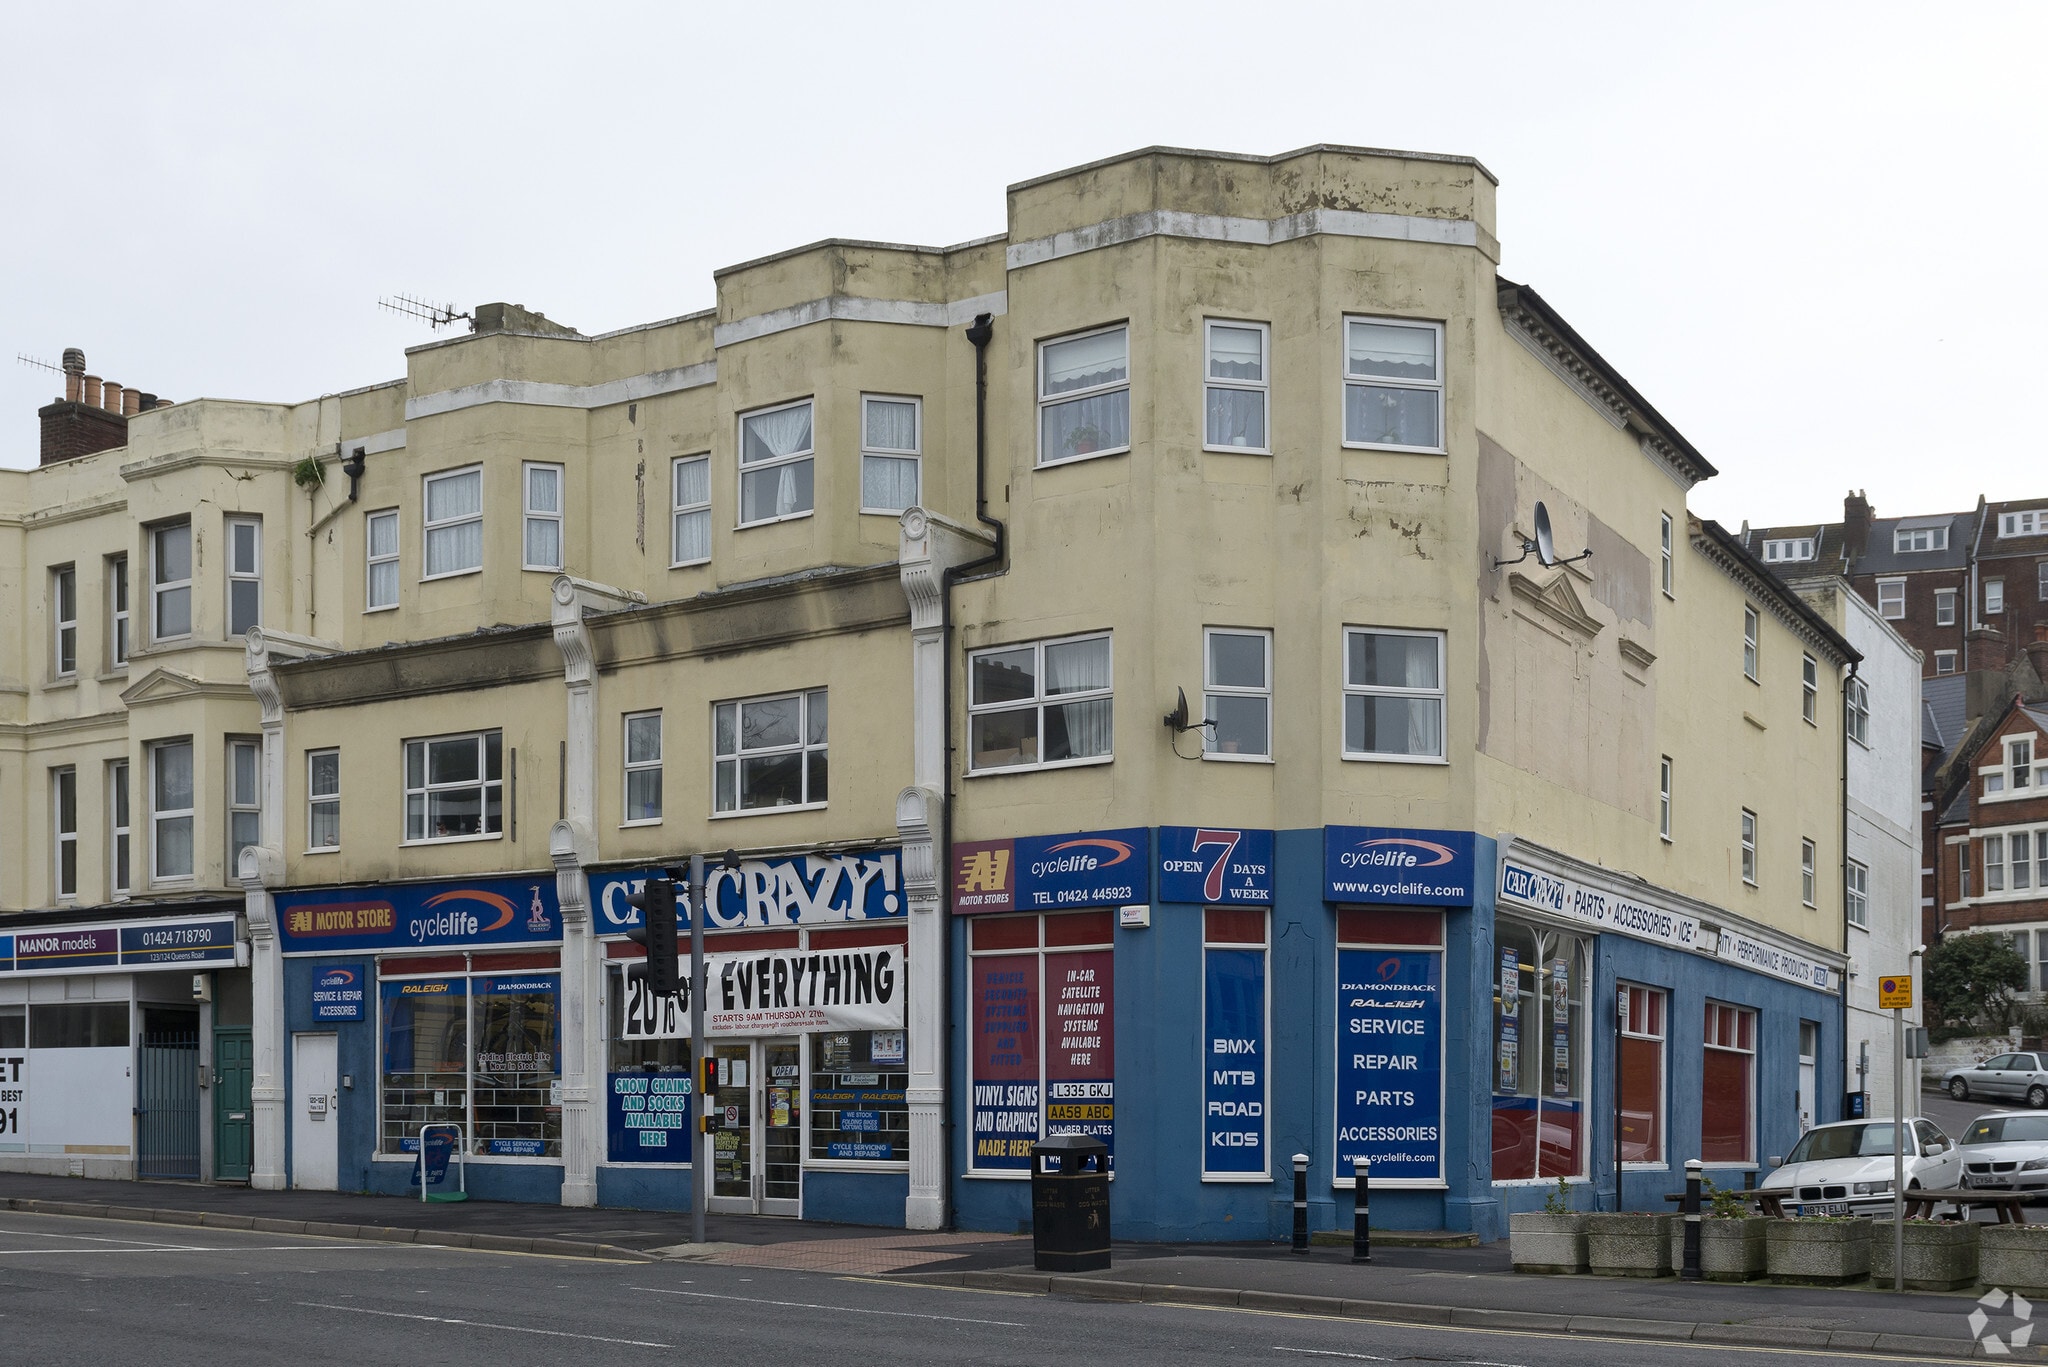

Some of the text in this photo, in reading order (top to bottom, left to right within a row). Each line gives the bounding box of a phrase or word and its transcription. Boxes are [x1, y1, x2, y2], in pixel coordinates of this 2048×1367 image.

[1192, 829, 1241, 901] 7
[1341, 850, 1417, 868] cyclelife
[1031, 855, 1098, 878] cyclelife
[1163, 860, 1203, 872] OPEN
[1233, 864, 1266, 874] DAYS
[1244, 877, 1254, 886] A
[705, 854, 899, 928] CRAZY!
[1033, 887, 1132, 904] TEL 01424 445923
[1229, 889, 1269, 899] WEEK
[1333, 882, 1464, 897] www.cyclelife.com
[1506, 870, 1564, 908] CAR CRAZY!
[959, 893, 1009, 906] MOTOR STORES
[316, 909, 391, 931] MOTOR STORE
[1573, 890, 1692, 943] PARTS ACCESSORIES ICE
[410, 912, 479, 943] cyclelife
[20, 934, 97, 953] MANOR models
[143, 928, 212, 946] 01424 718790
[150, 951, 204, 961] 123/124 Queens Road
[1737, 939, 1779, 971] PERFORMANCE
[1781, 955, 1809, 981] PRODUCTS
[320, 977, 344, 987] cyclelife
[720, 951, 894, 1011] EVERYTHING
[987, 972, 1025, 984] VEHICLE
[1067, 969, 1095, 982] IN-CAR
[402, 984, 448, 993] RALEIGH
[497, 982, 552, 991] DIAMONDBACK
[1062, 986, 1100, 999] SATELLITE
[1341, 983, 1436, 991] DIAMONDBACK
[313, 991, 362, 1001] SERVICE & REPAIR
[984, 988, 1028, 1000] SECURITY
[319, 1006, 357, 1016] ACCESSORIES
[713, 1009, 824, 1022] STARTS 9AM THURSDAY 27th
[986, 1005, 1027, 1018] SYSTEMS
[1057, 1002, 1104, 1016] NAVIGATION
[984, 1021, 1028, 1034] SUPPLIED
[1063, 1019, 1099, 1032] SYSTEMS
[1350, 1018, 1425, 1035] SERVICE
[997, 1037, 1015, 1049] AND
[1061, 1036, 1101, 1049] AVAILABLE
[1213, 1039, 1256, 1054] BMX
[477, 1052, 550, 1062] Folding Electric Bike
[990, 1053, 1022, 1066] FITTED
[1070, 1053, 1091, 1065] HERE
[1353, 1054, 1418, 1070] REPAIR
[490, 1061, 538, 1071] Now In Stock
[775, 1066, 794, 1076] OPEN
[1213, 1070, 1256, 1086] MTB
[615, 1078, 692, 1094] SNOW CHAINS
[1057, 1084, 1111, 1097] L335 GKJ
[1, 1090, 23, 1102] BEST
[975, 1085, 1038, 1106] VINYL SIGNS
[1356, 1090, 1415, 1106] PARTS
[621, 1095, 685, 1112] AND SOCKS
[1208, 1101, 1262, 1117] ROAD
[1050, 1106, 1110, 1118] AA58 ABC
[625, 1112, 682, 1129] AVAILABLE
[975, 1111, 1038, 1133] AND GRAPHICS
[1048, 1125, 1112, 1135] NUMBER PLATES
[1339, 1126, 1438, 1141] ACCESSORIES
[512, 1140, 541, 1148] SERVICING
[639, 1130, 667, 1147] HERE
[1212, 1131, 1259, 1147] KIDS
[853, 1143, 887, 1151] SERVICING
[977, 1139, 1036, 1156] MADE HERE
[1342, 1153, 1435, 1164] wwwcyclelife.com
[1804, 1204, 1846, 1214] N873 ELU
